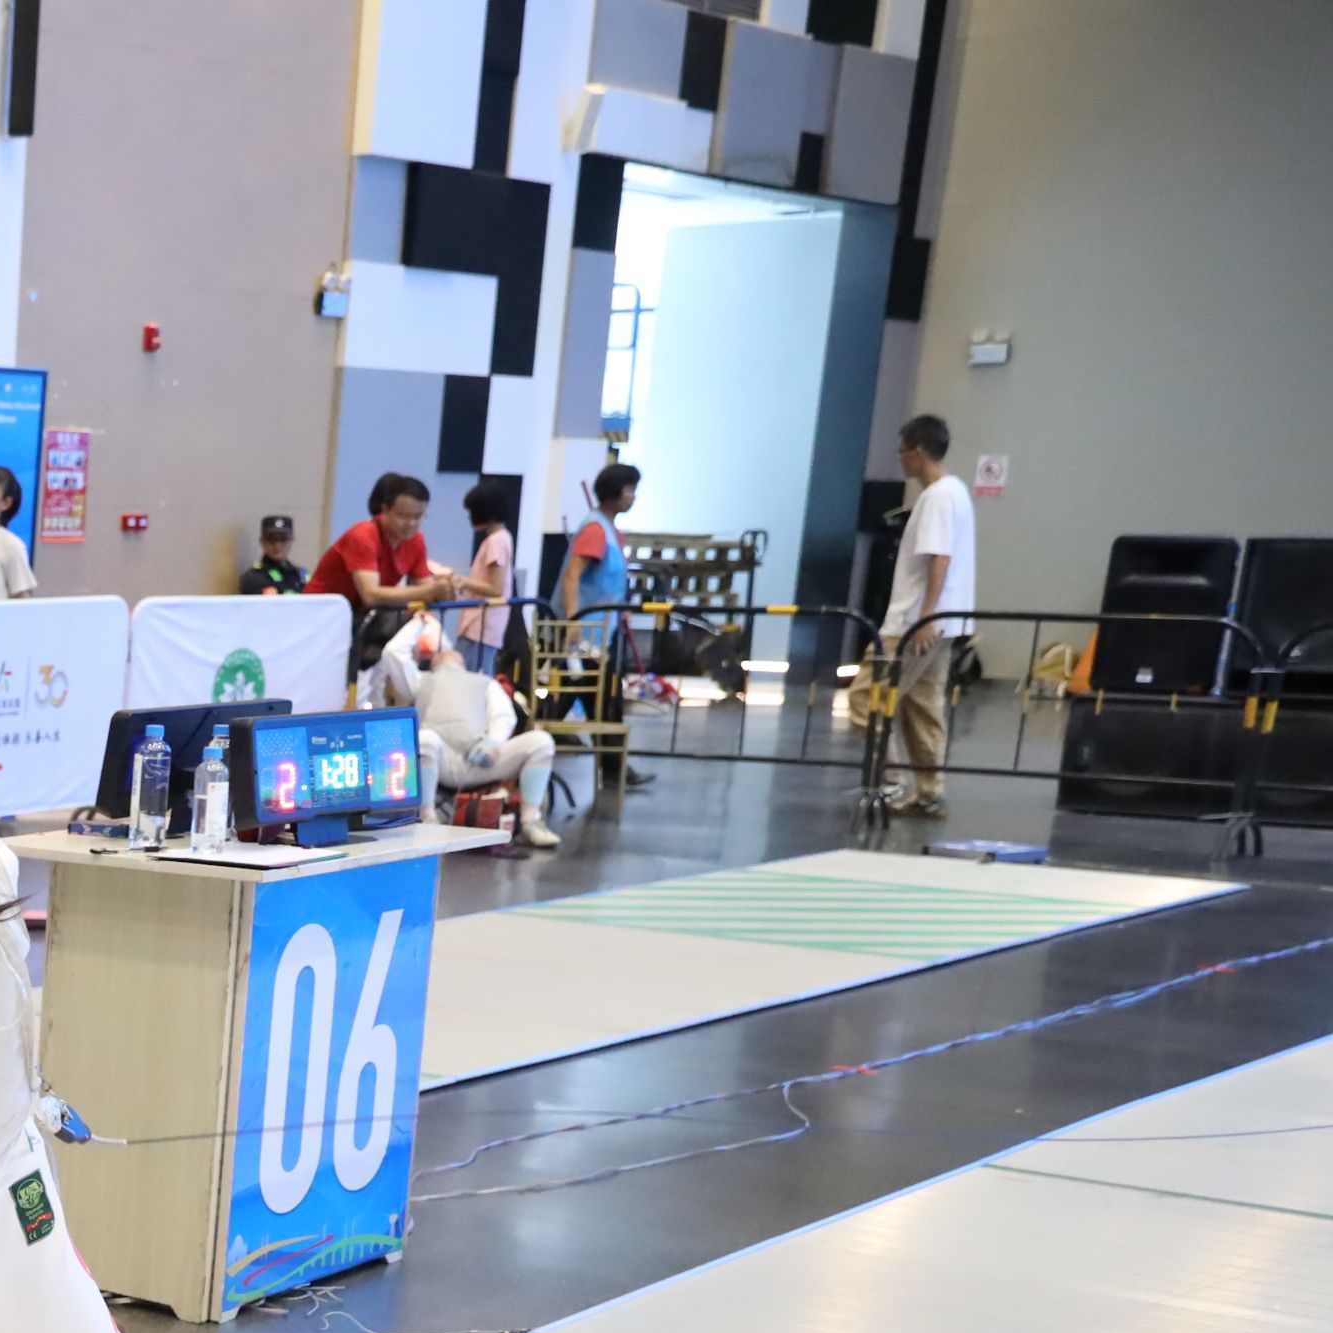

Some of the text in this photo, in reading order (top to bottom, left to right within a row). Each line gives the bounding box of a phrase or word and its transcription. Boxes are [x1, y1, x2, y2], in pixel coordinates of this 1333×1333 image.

[277, 752, 407, 810] 2 1:28 2
[258, 908, 404, 1214] 06
